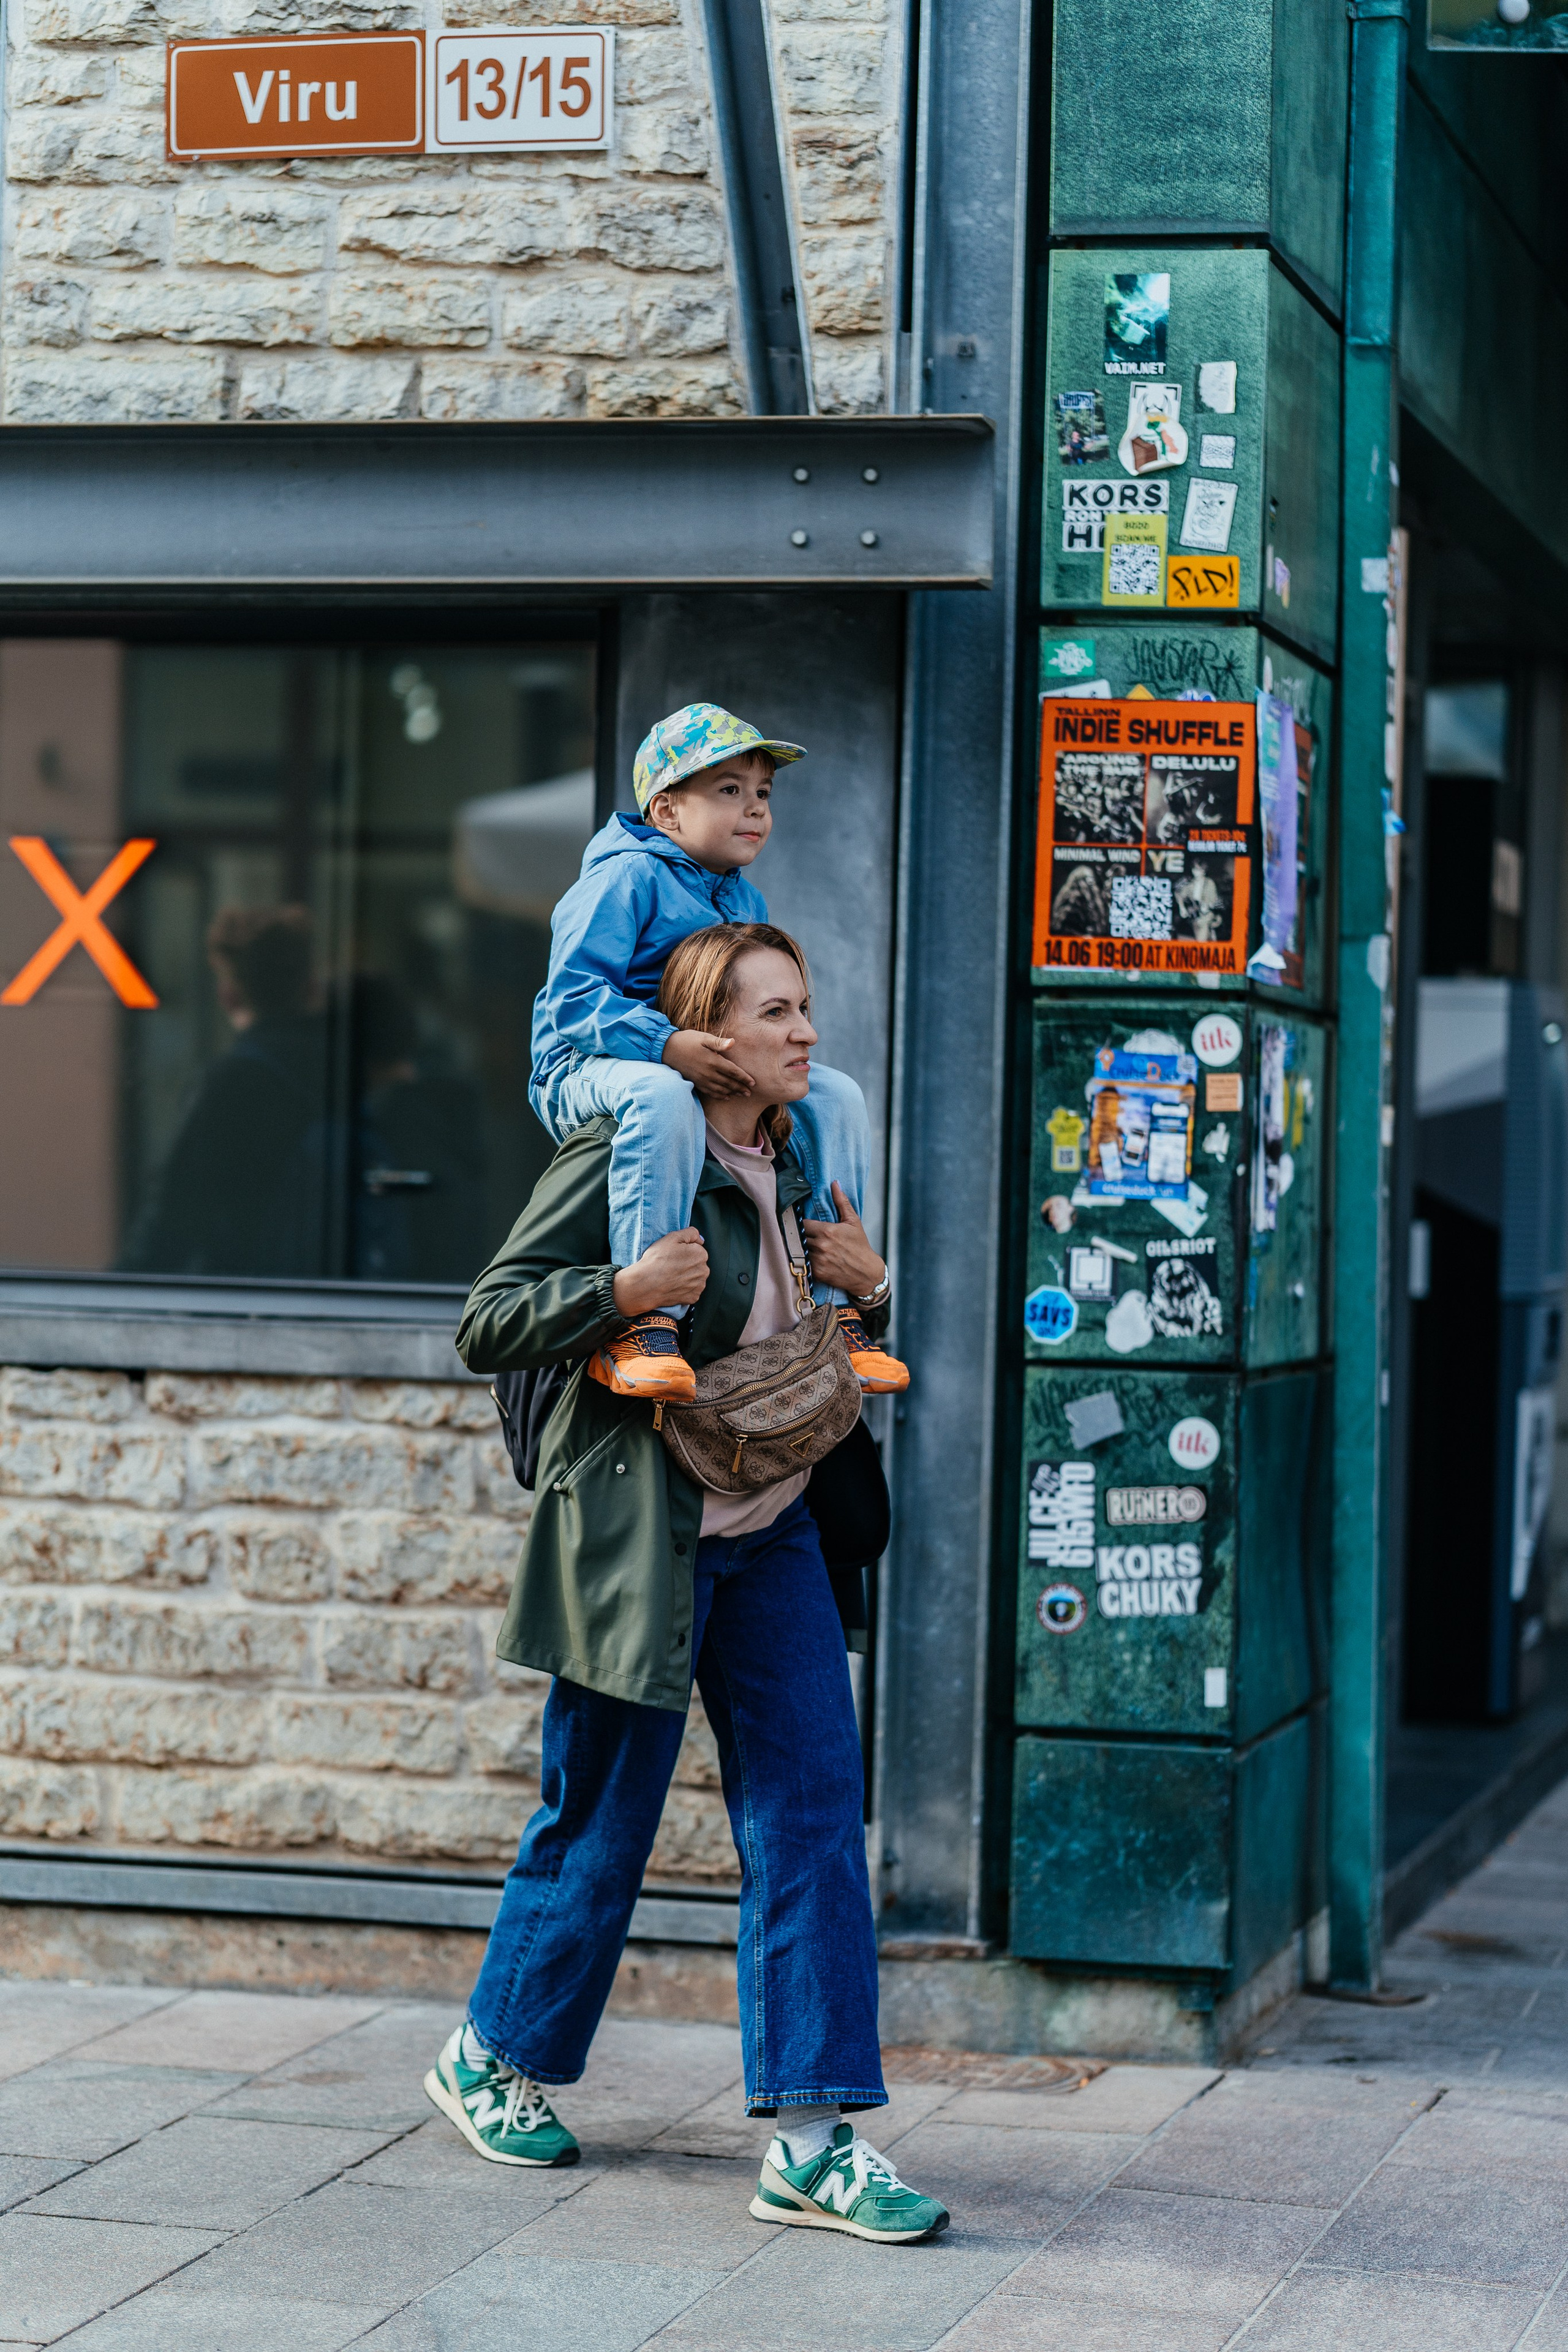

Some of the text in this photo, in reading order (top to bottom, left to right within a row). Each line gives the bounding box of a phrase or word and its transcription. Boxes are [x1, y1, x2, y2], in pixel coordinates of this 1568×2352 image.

[233, 70, 357, 124] Viru
[445, 56, 592, 121] 13/15
[1069, 484, 1161, 507] KORS
[1055, 707, 1120, 717] TALLINN
[1054, 717, 1245, 747] INDIE SHUFFLE
[1152, 755, 1237, 771] DELULU
[1054, 848, 1142, 863] MINIMAL WIND
[1147, 850, 1185, 873] YE
[0, 835, 159, 1008] X
[1045, 940, 1236, 970] 14.06 19:00 AT KINOMAJA
[1096, 1542, 1202, 1581] KORS
[1098, 1578, 1202, 1618] CHUKY
[812, 2169, 864, 2215] N
